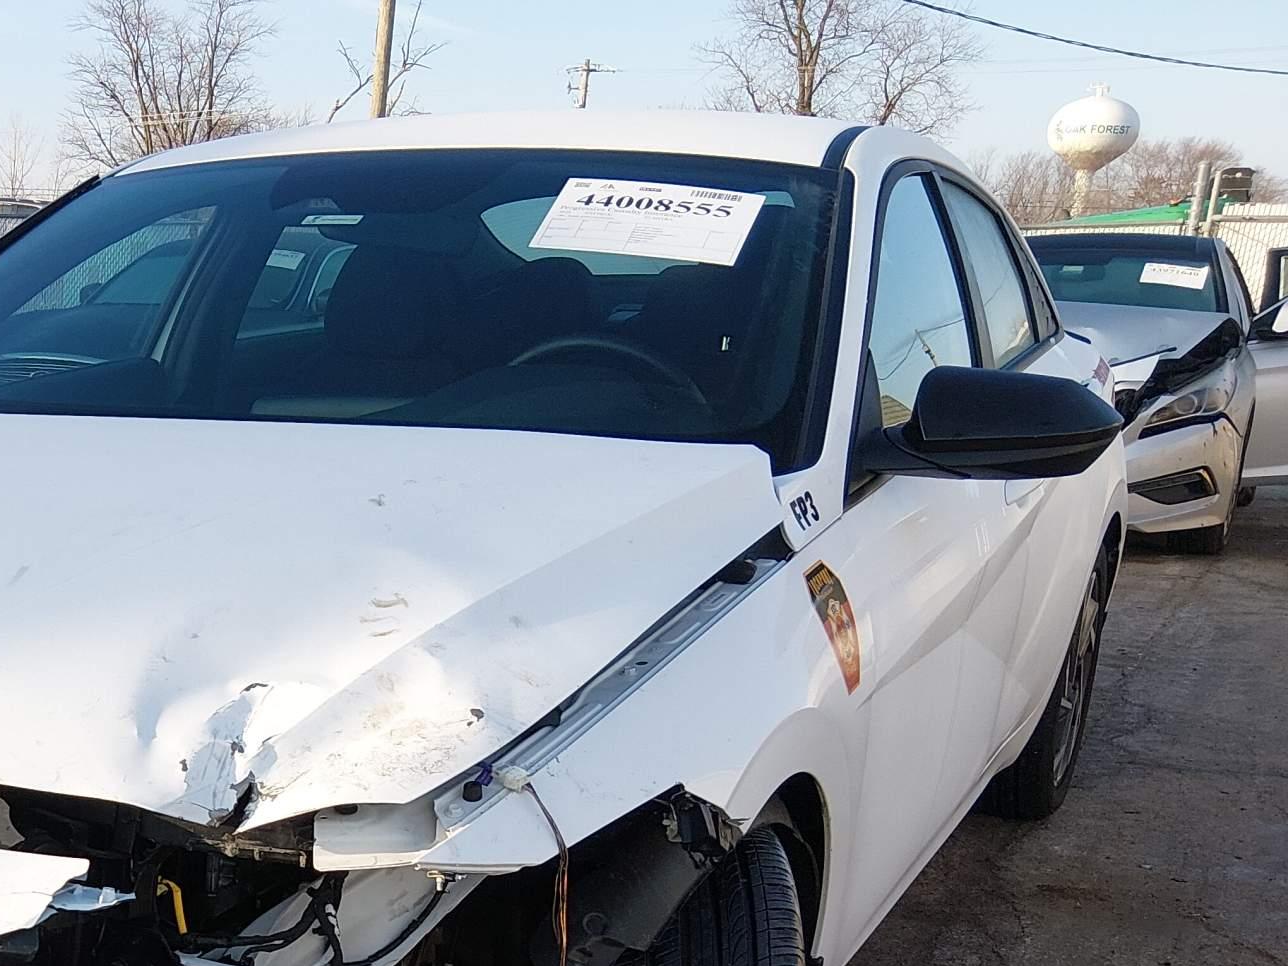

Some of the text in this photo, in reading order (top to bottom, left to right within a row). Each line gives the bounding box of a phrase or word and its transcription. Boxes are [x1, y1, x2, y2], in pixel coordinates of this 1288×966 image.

[1091, 125, 1131, 134] FOREST
[576, 194, 734, 217] 44008555
[790, 491, 820, 531] FP3
